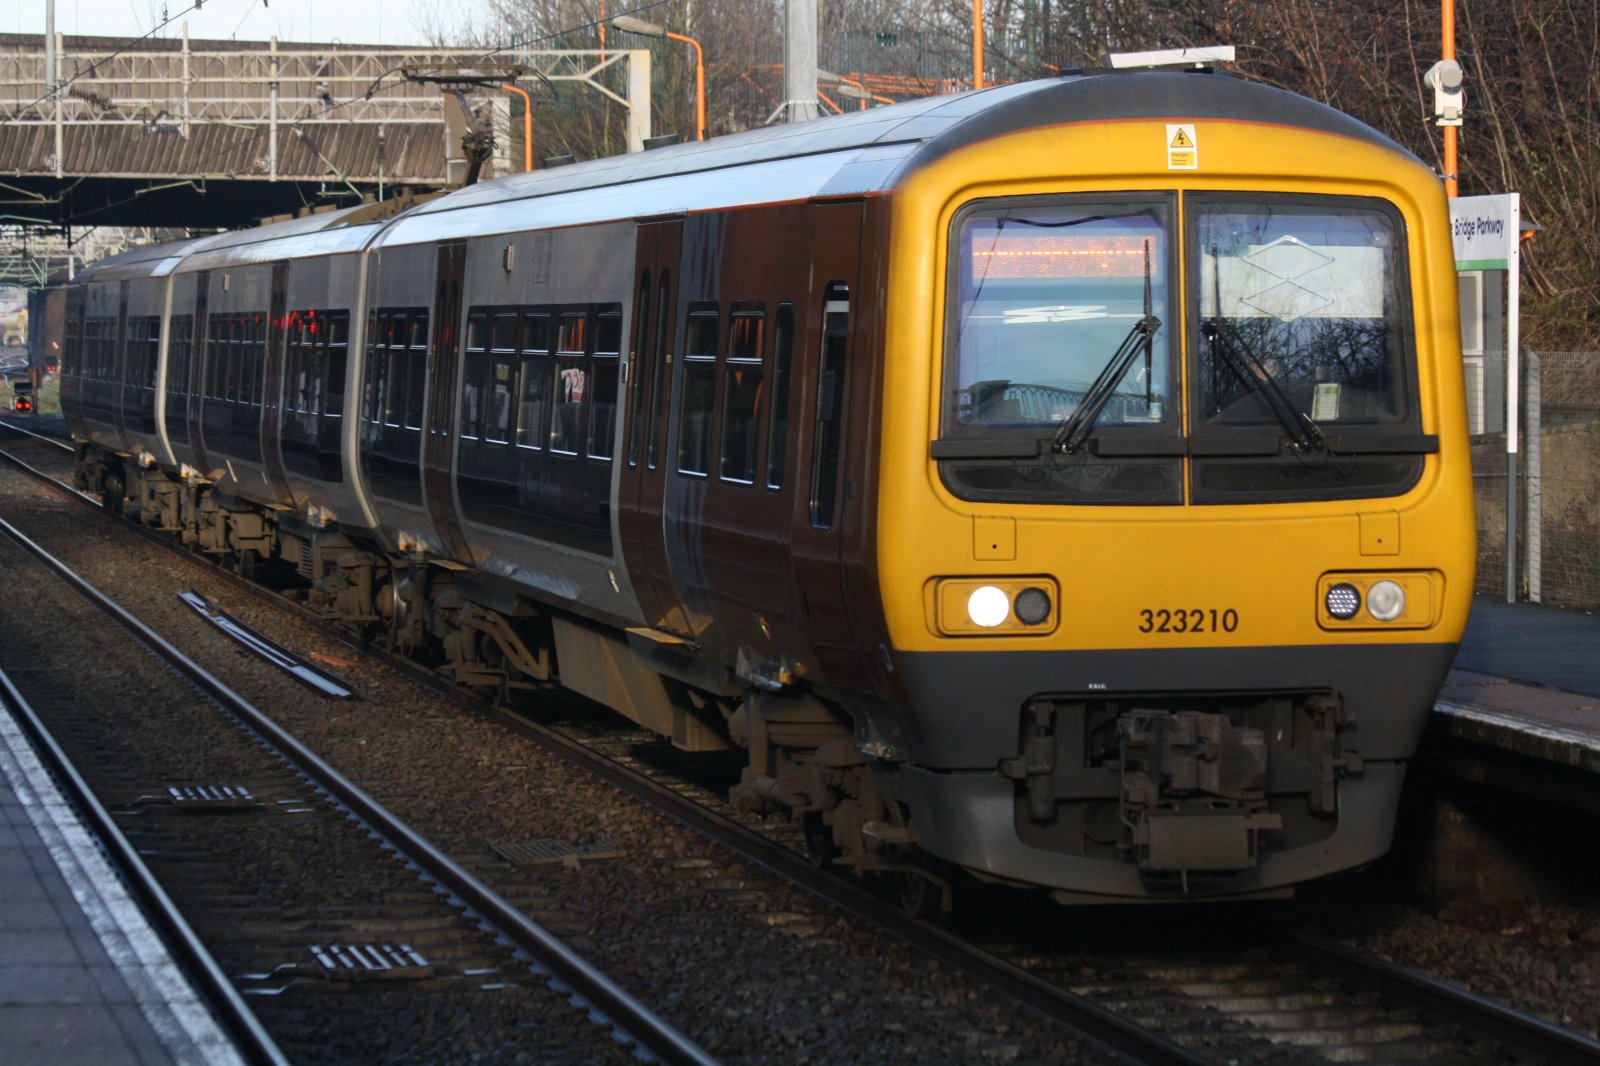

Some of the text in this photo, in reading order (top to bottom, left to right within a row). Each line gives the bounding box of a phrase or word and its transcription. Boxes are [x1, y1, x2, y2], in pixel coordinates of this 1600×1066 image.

[1455, 217, 1475, 240] Bridge
[1477, 216, 1504, 239] Parkway
[1138, 608, 1239, 633] 323210
